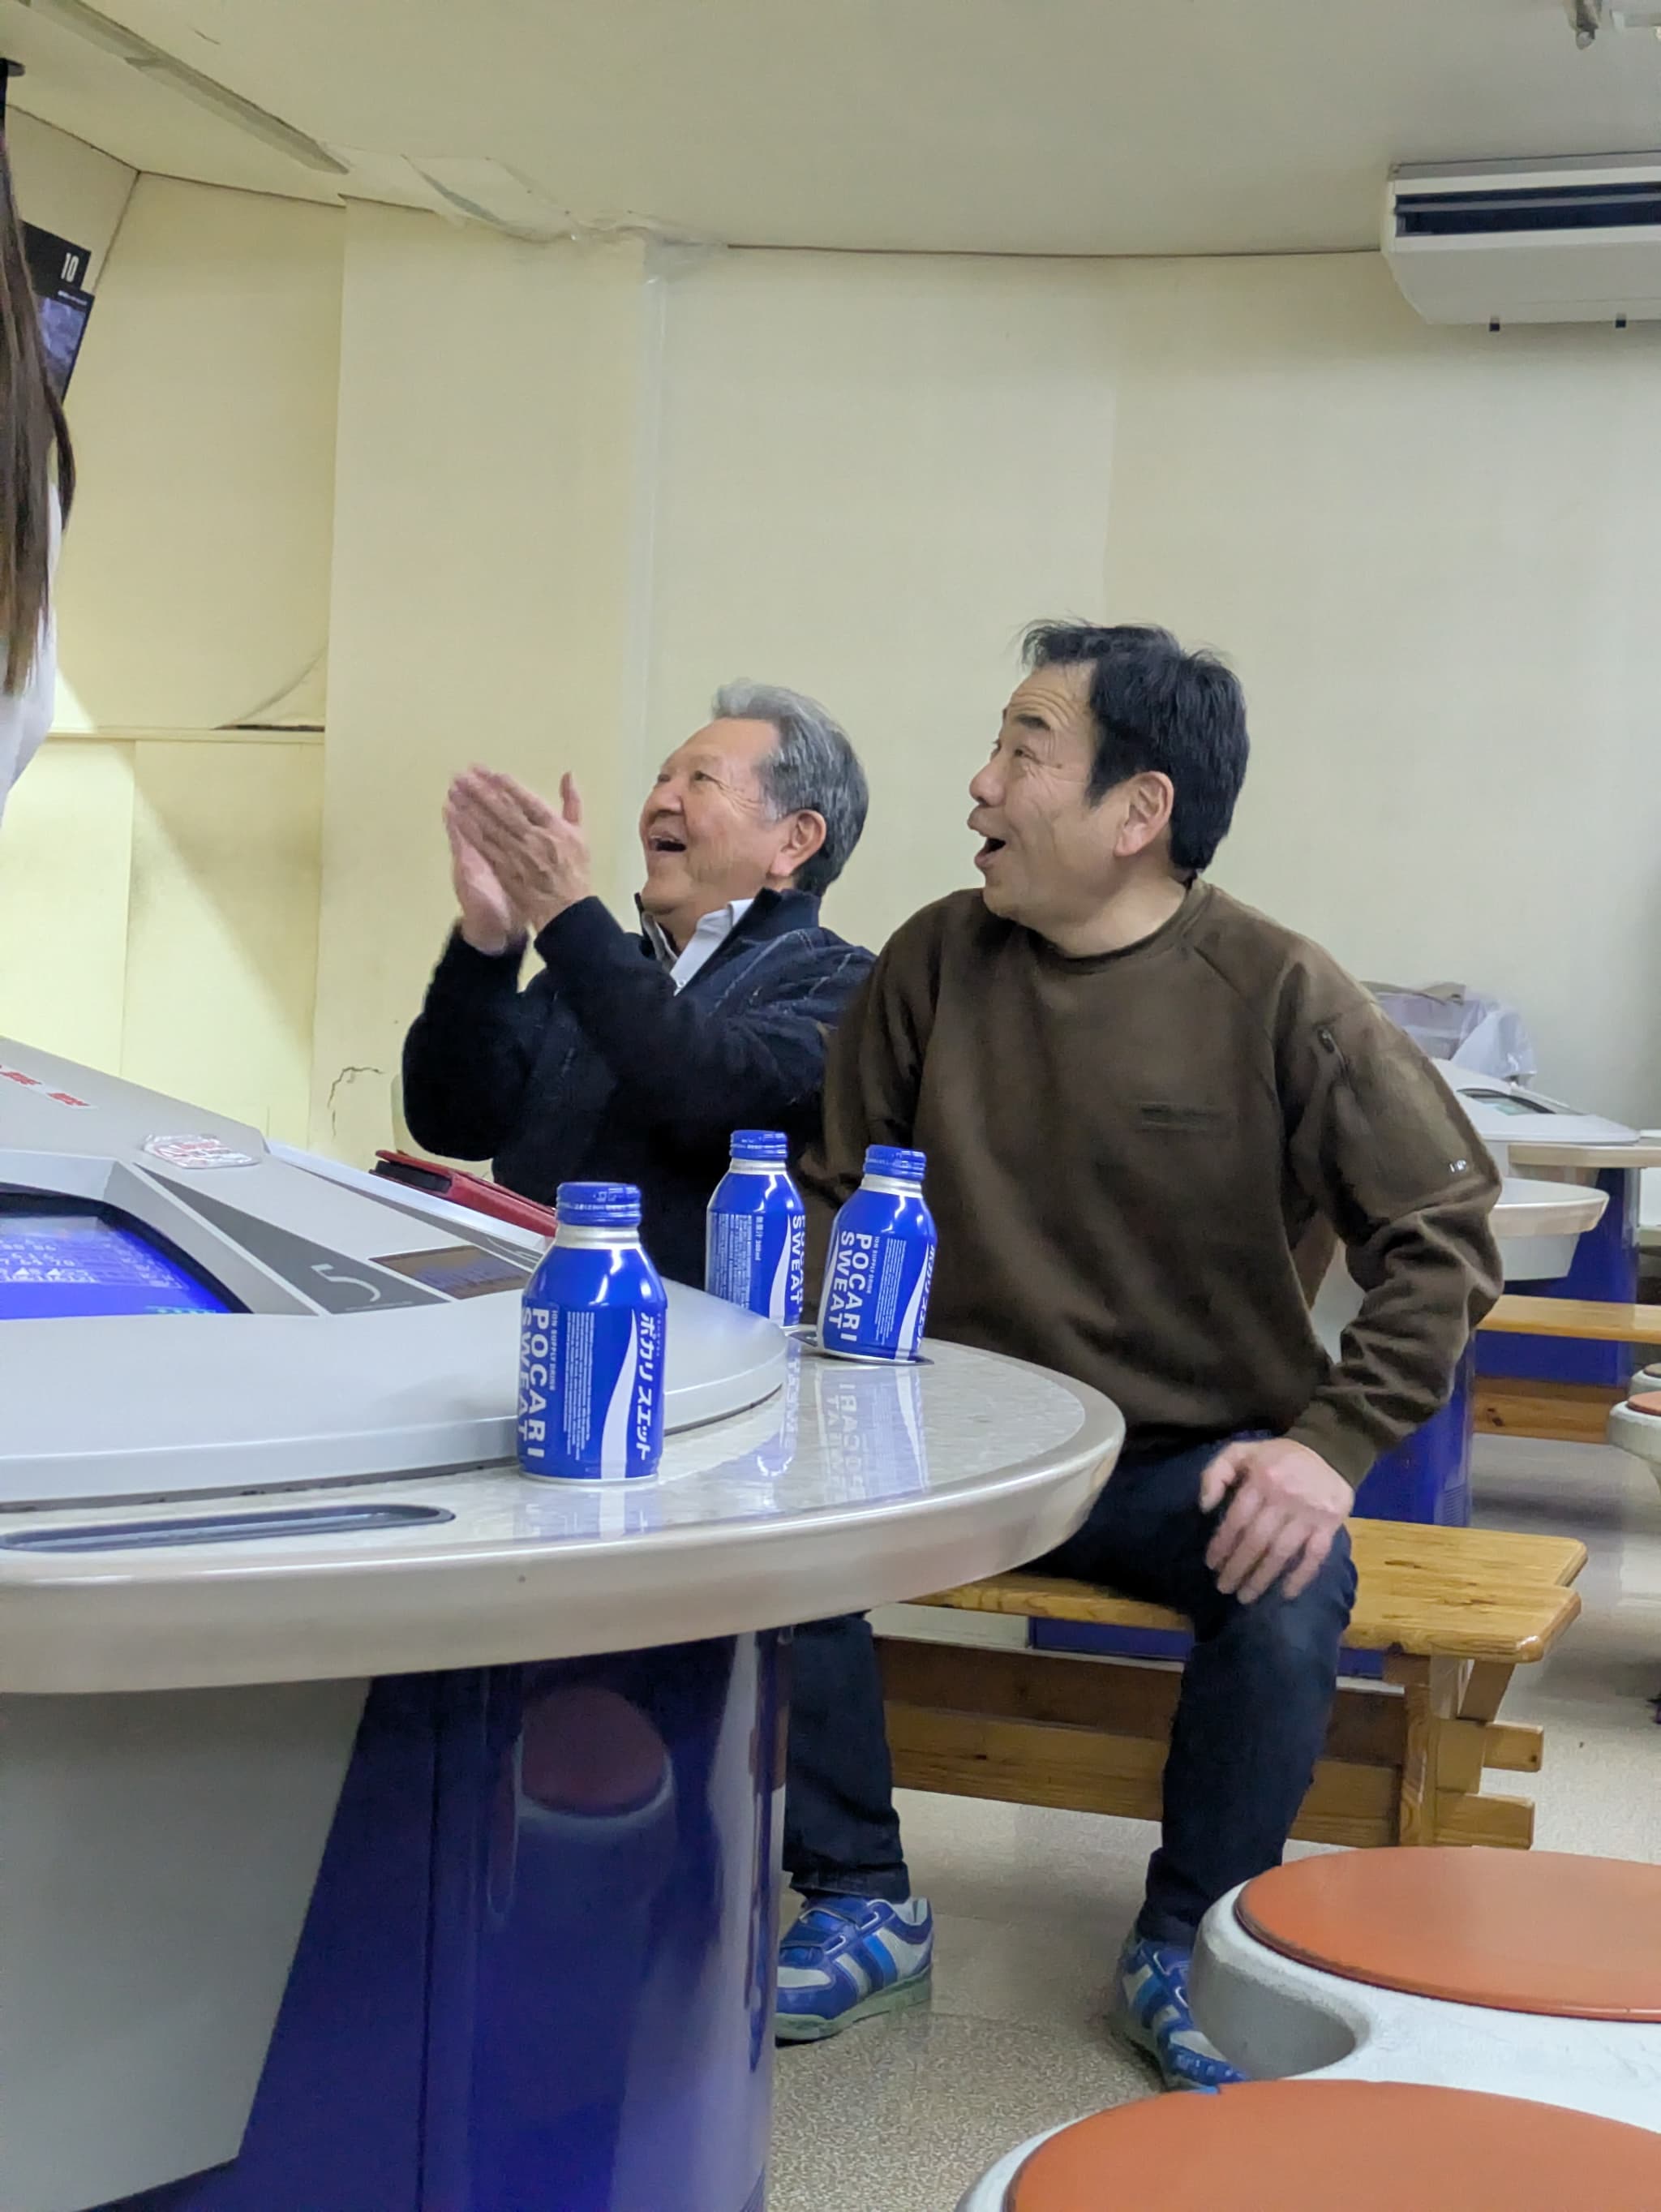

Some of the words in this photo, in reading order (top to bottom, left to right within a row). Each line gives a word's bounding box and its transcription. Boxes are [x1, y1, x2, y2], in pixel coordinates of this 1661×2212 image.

[61, 252, 79, 282] 10
[311, 1263, 380, 1302] 5
[790, 1215, 802, 1304] SWEAT
[828, 1231, 855, 1329] SWEAT
[840, 1233, 873, 1342] POCARI
[527, 1308, 550, 1458] POCARI
